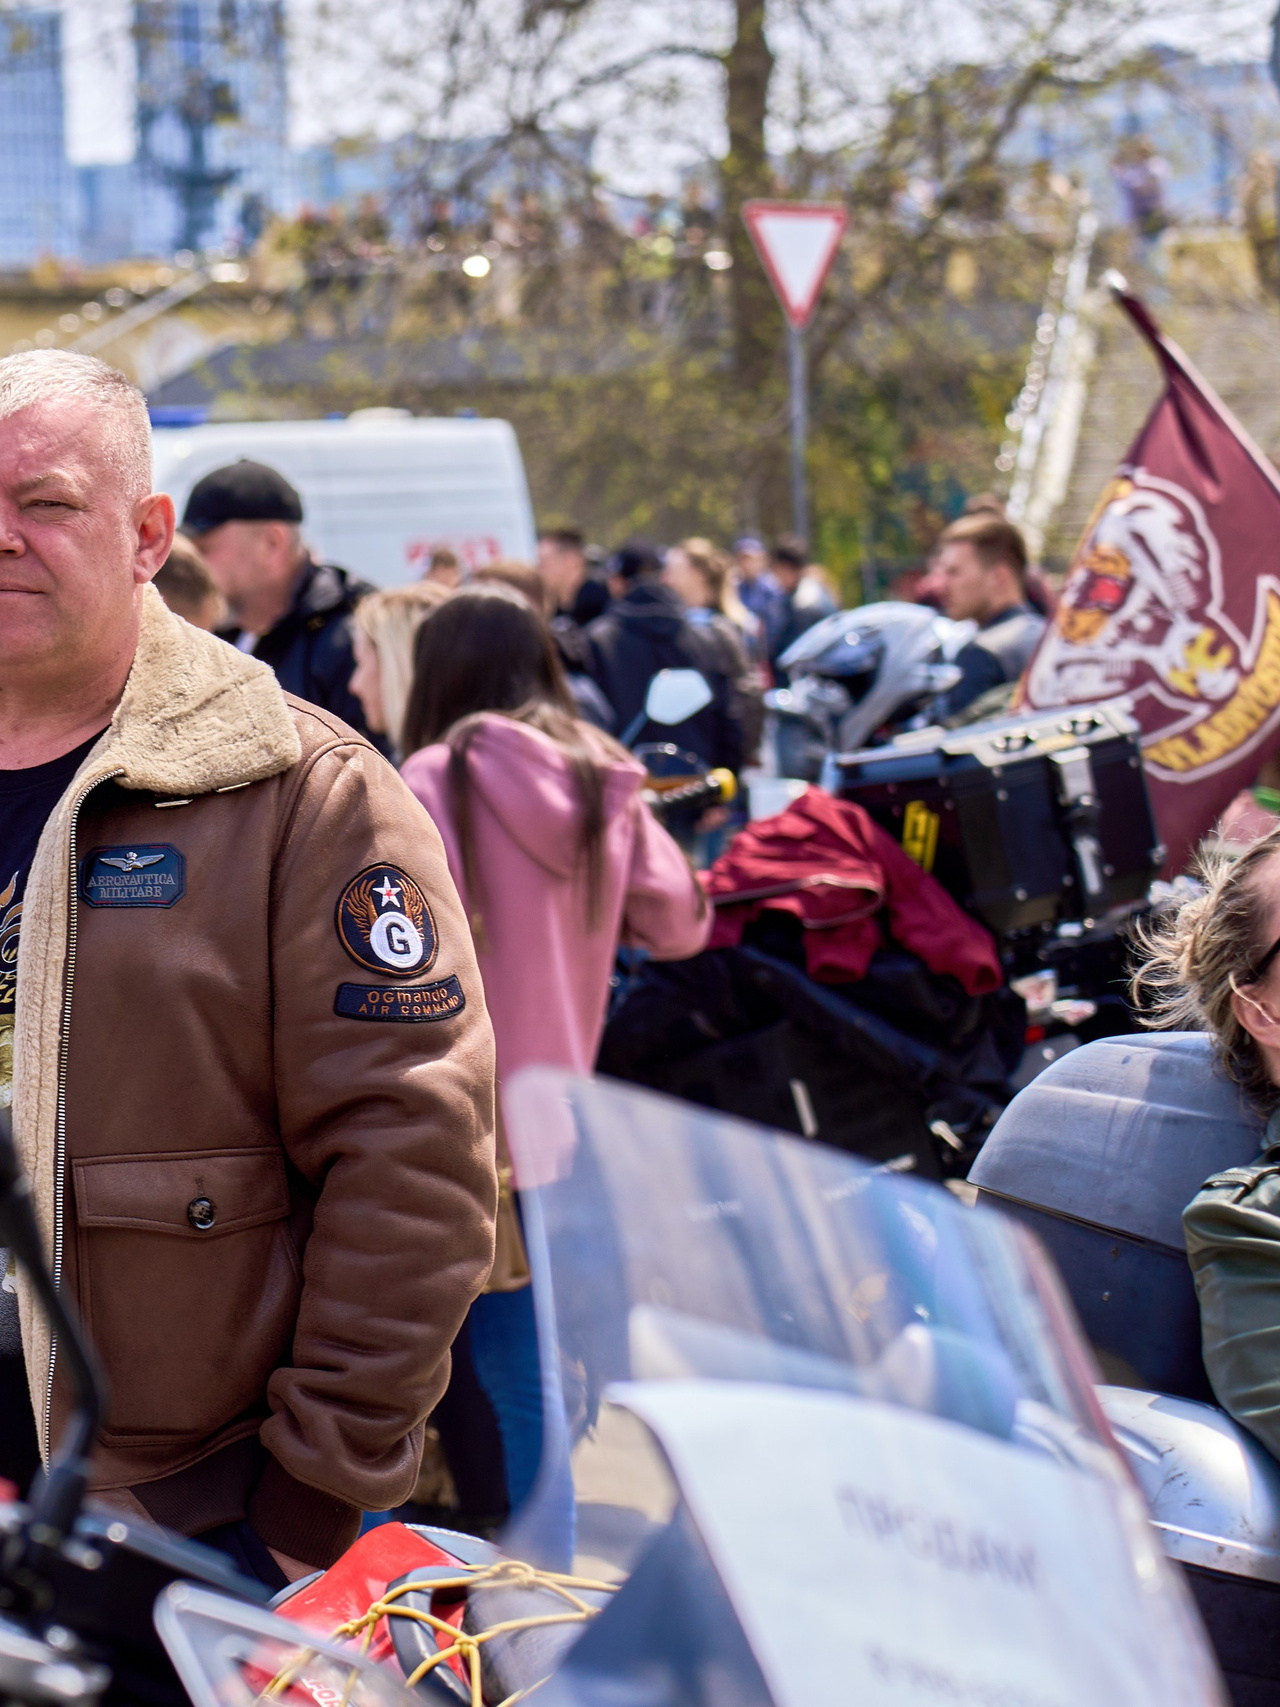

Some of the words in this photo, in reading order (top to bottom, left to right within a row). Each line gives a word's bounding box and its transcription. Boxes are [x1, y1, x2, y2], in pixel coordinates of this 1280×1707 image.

[87, 874, 176, 887] AERONAUTICA
[385, 922, 411, 955] G
[359, 1005, 389, 1015] AIR
[401, 995, 459, 1015] COMMAND
